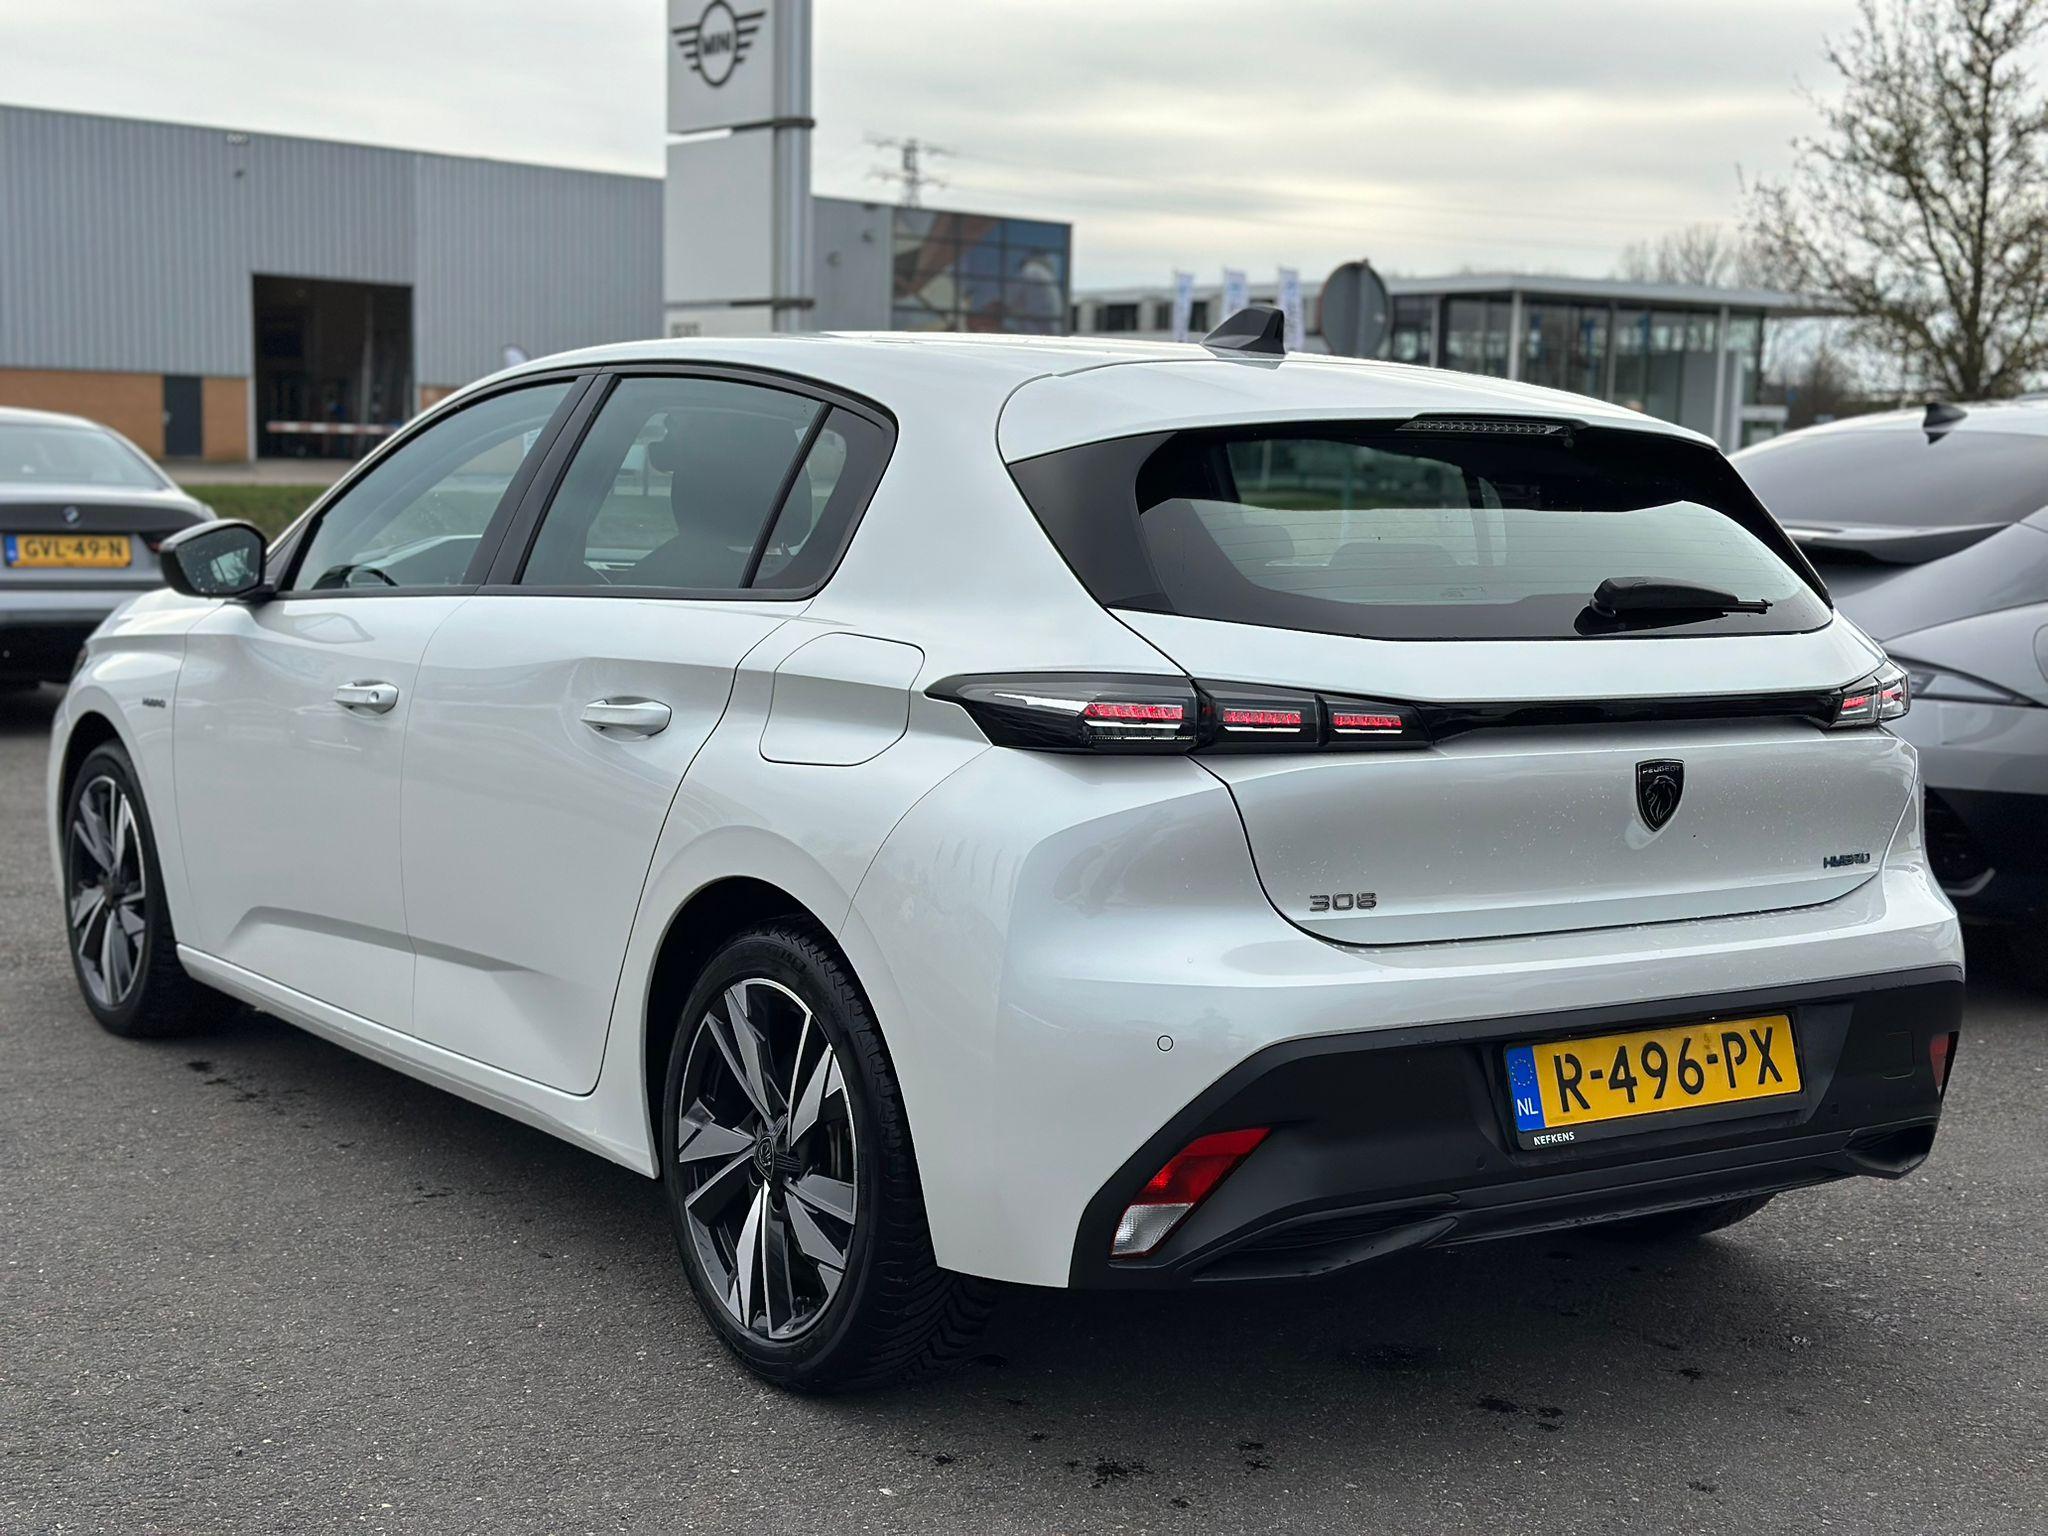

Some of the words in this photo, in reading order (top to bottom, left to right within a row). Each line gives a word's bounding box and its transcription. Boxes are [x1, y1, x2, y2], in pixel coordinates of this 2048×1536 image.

[24, 539, 122, 557] GVL-49-N
[1642, 765, 1680, 774] PEUGEOT
[1309, 893, 1377, 912] 308
[1553, 1027, 1783, 1112] R-496-PX
[1517, 1097, 1539, 1117] NL
[1533, 1131, 1575, 1146] NEFKENS
